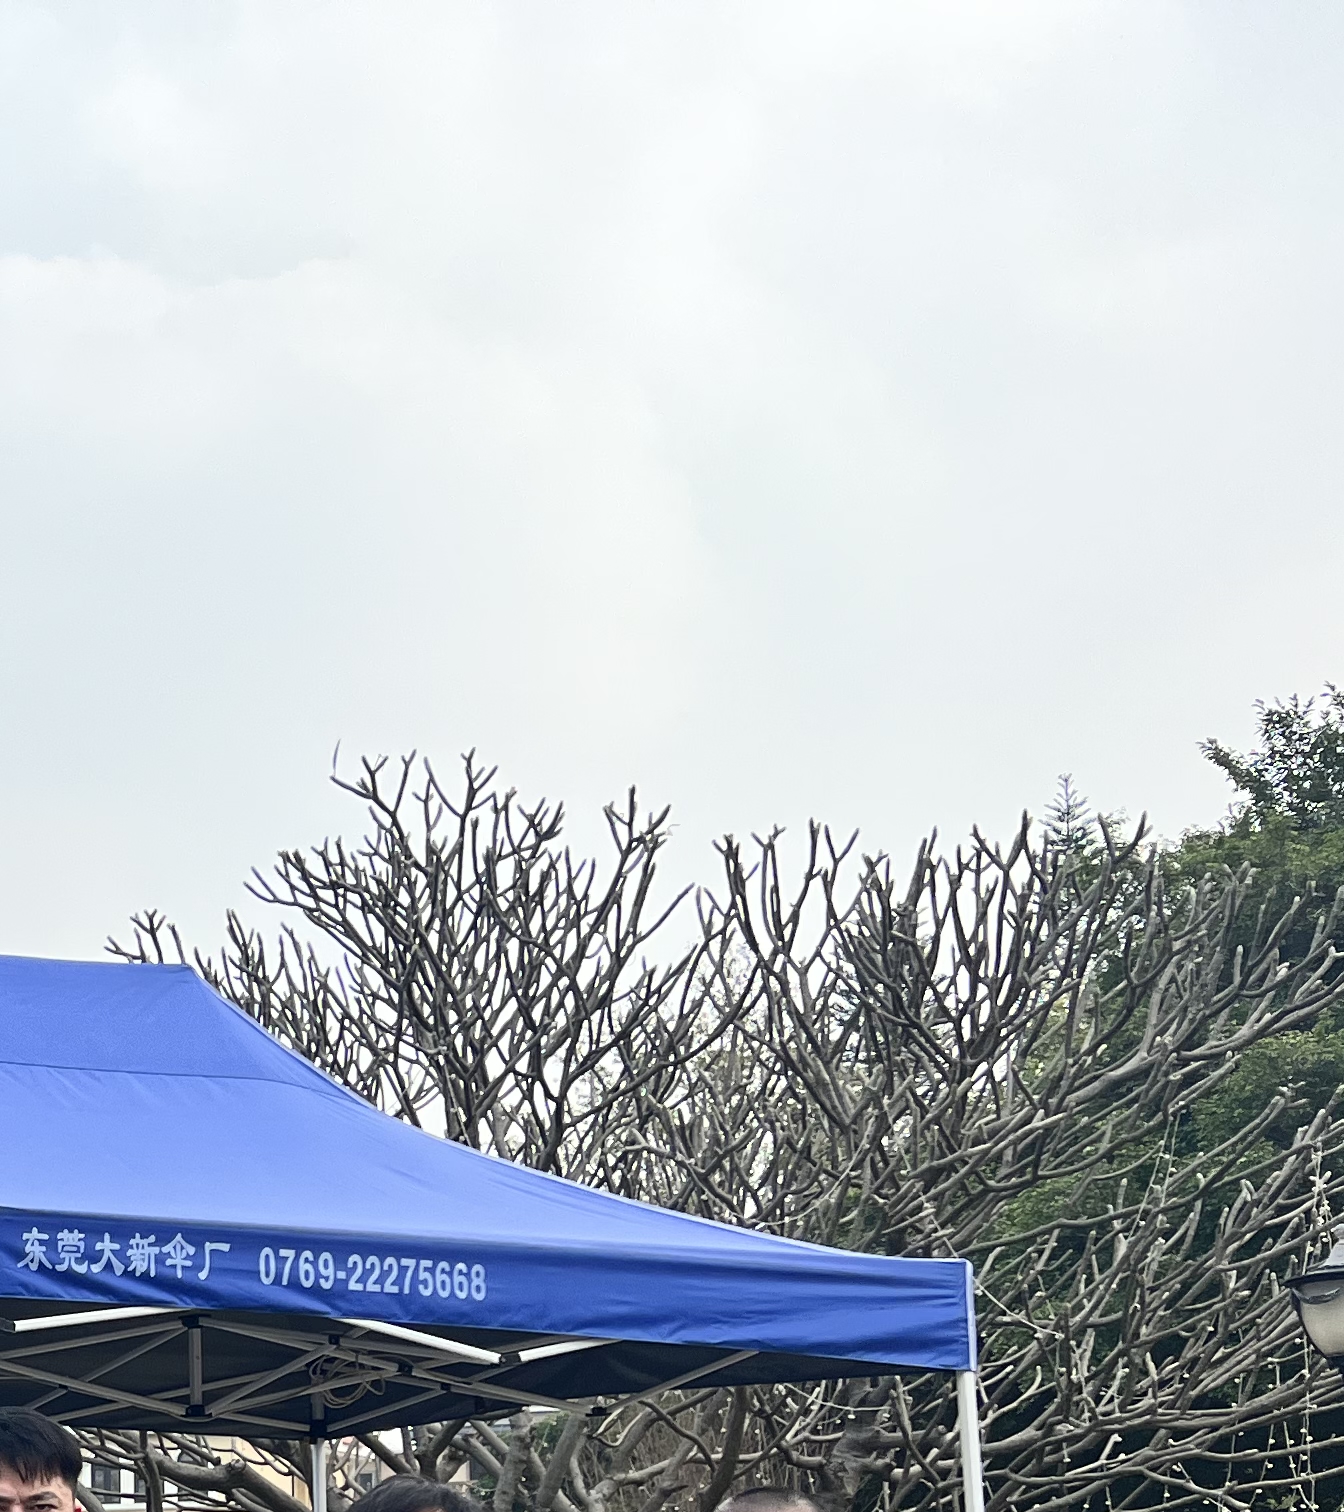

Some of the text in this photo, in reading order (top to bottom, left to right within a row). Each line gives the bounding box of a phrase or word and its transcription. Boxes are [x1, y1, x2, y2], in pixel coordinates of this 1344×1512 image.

[16, 1228, 487, 1301] 东莞大新伞厂 0769-22275668
